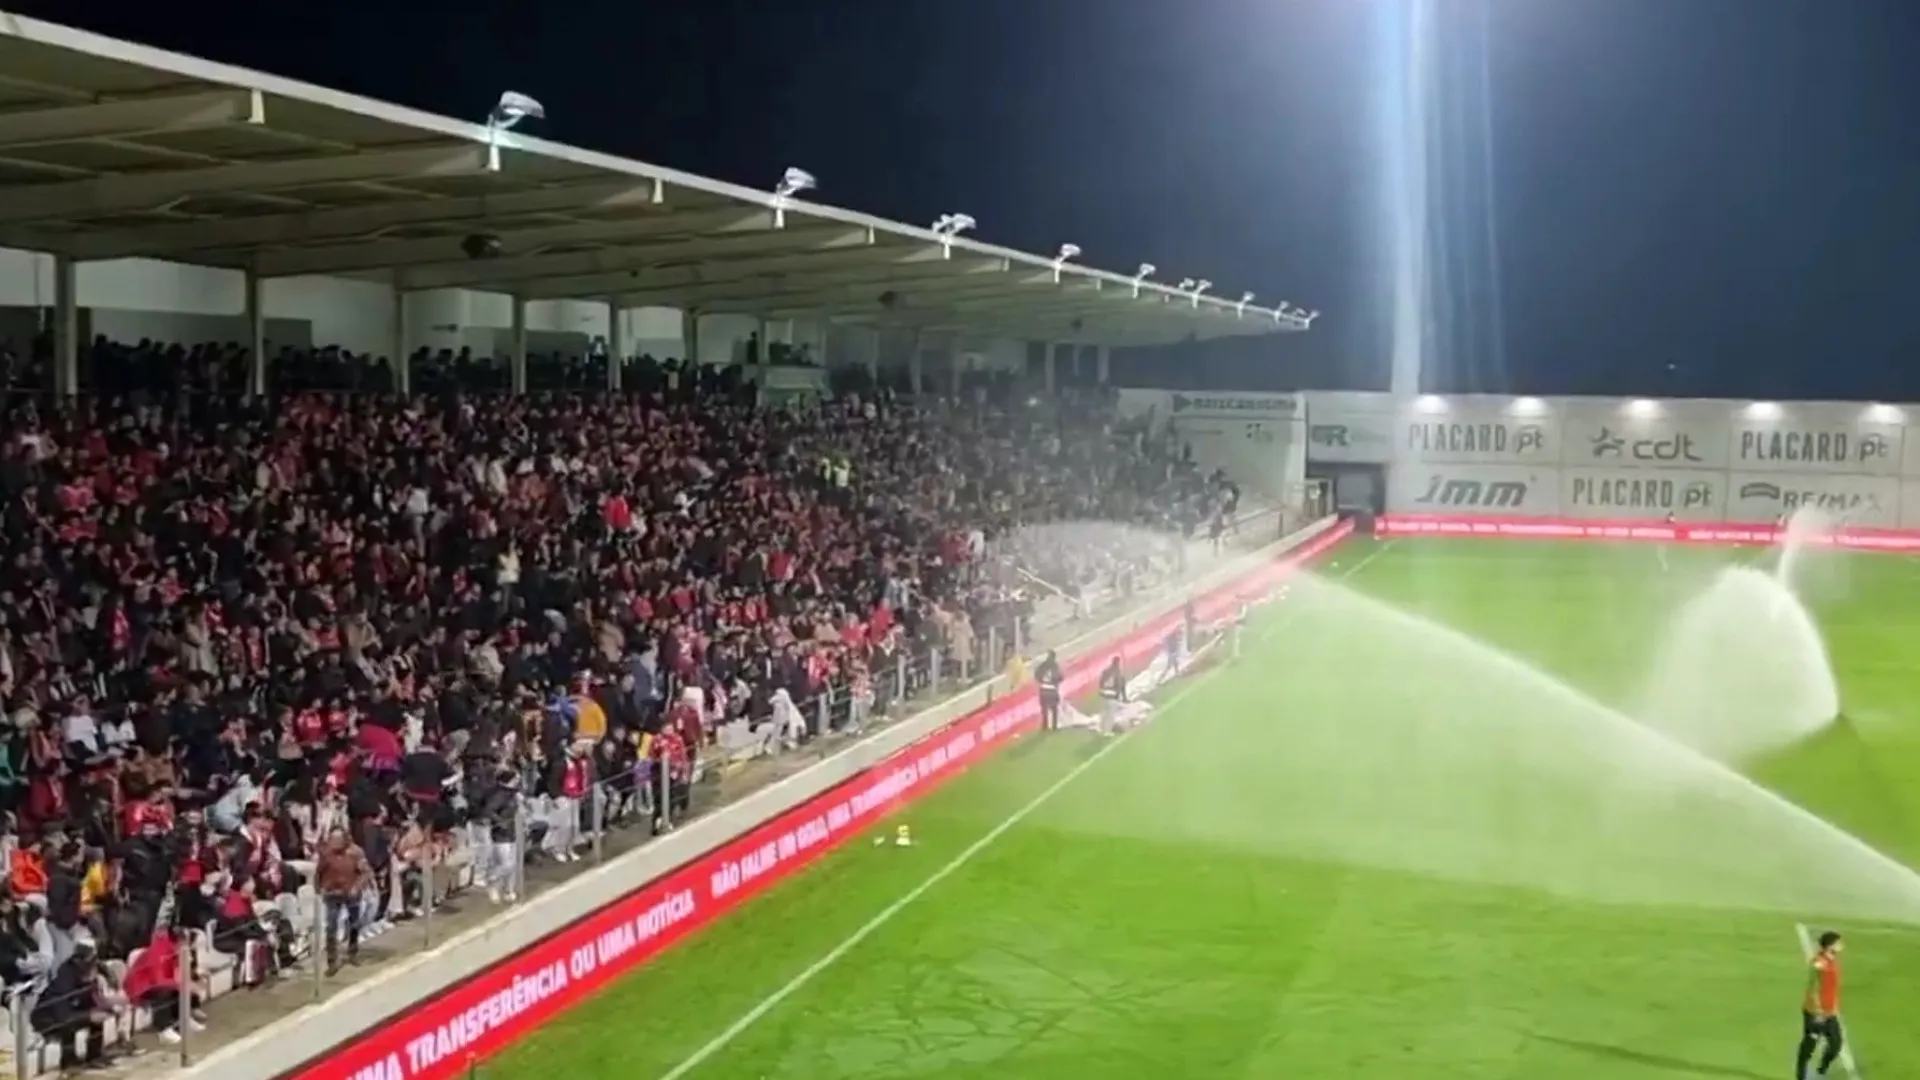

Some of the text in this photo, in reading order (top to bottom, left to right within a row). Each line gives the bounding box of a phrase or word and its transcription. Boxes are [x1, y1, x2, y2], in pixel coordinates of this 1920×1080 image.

[1408, 423, 1507, 451] PLACARD
[1515, 427, 1545, 453] pt
[1632, 432, 1704, 462] cdt
[1741, 430, 1889, 462] PLACARD pt
[1572, 477, 1712, 508] PLACARD pt
[405, 957, 569, 1076] TRANSFERÊNCIA
[569, 947, 596, 980] OU
[597, 917, 637, 966] UMA
